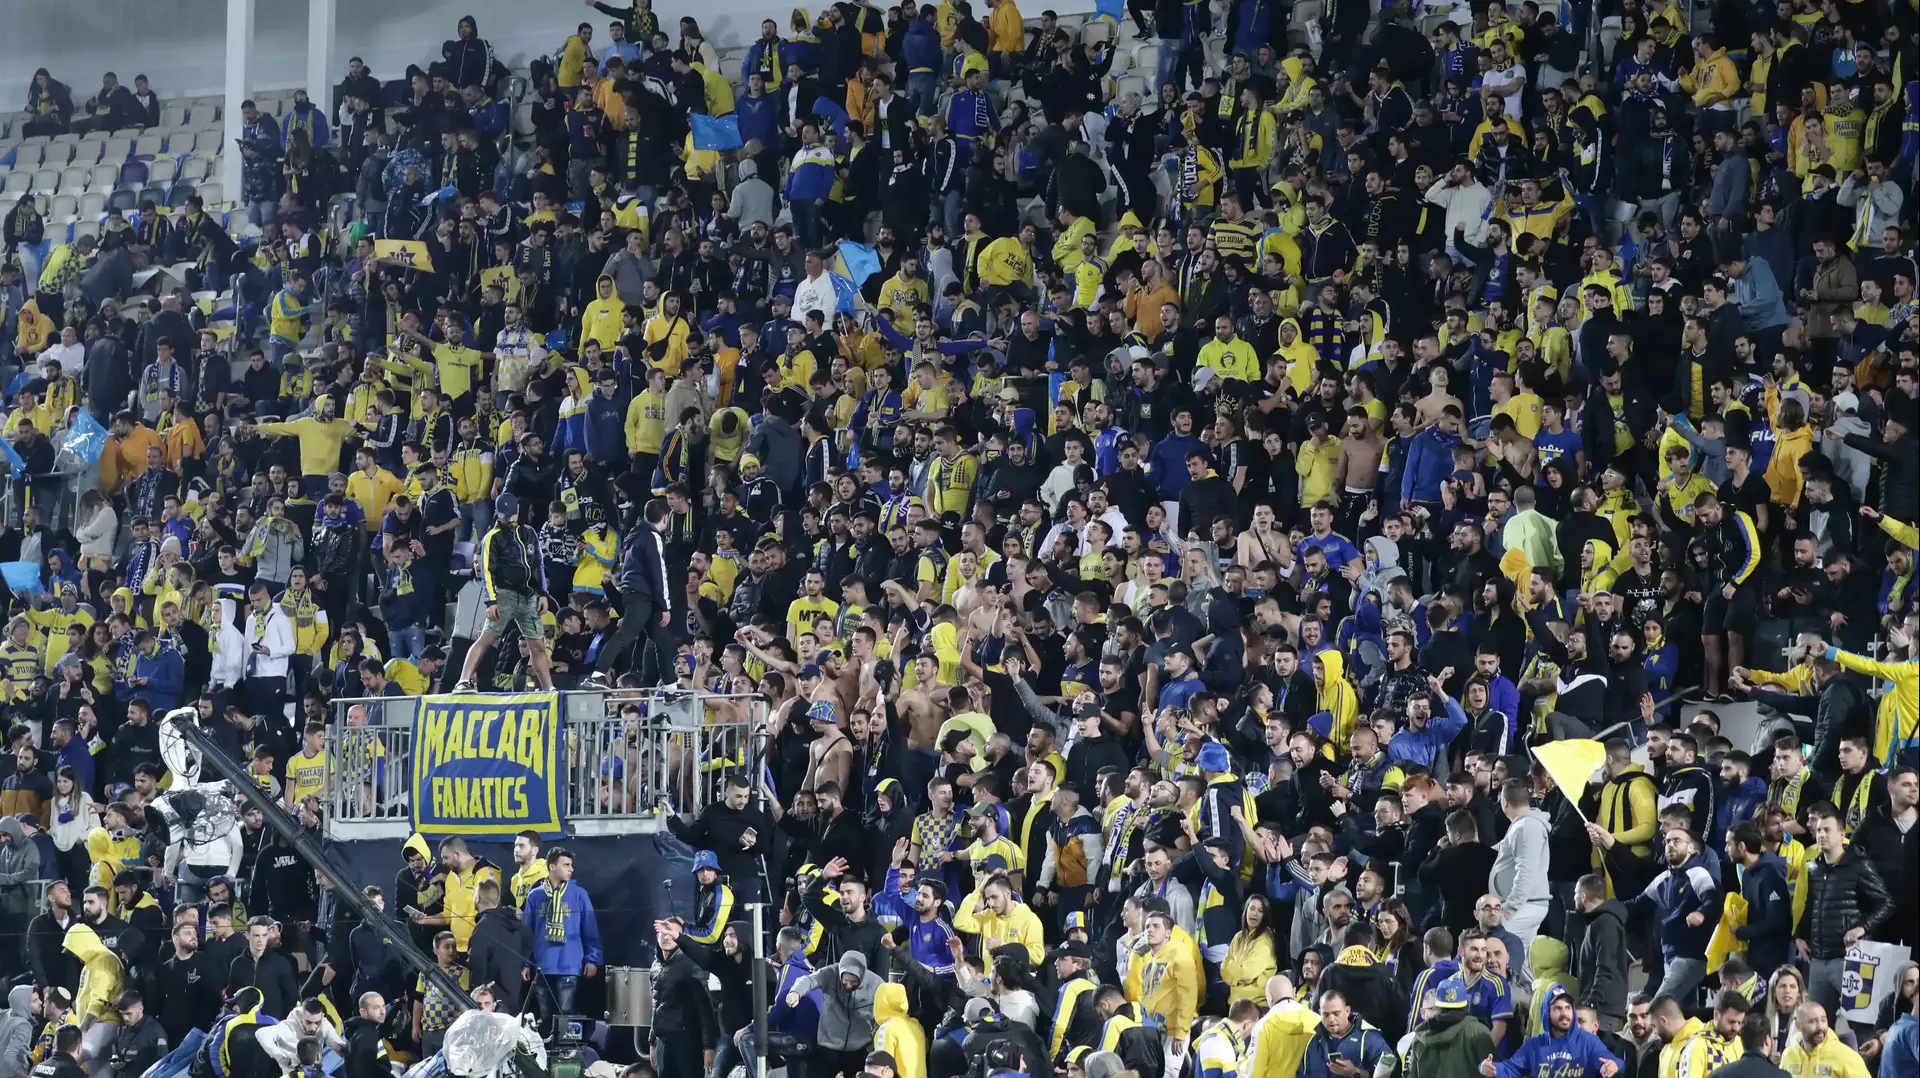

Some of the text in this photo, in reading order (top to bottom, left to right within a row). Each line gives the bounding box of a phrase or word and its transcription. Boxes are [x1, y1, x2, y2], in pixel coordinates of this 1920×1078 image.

[1751, 430, 1776, 443] FIL
[422, 709, 548, 780] MACCABI
[432, 776, 529, 819] FANATICS
[1553, 1062, 1585, 1078] Aviv
